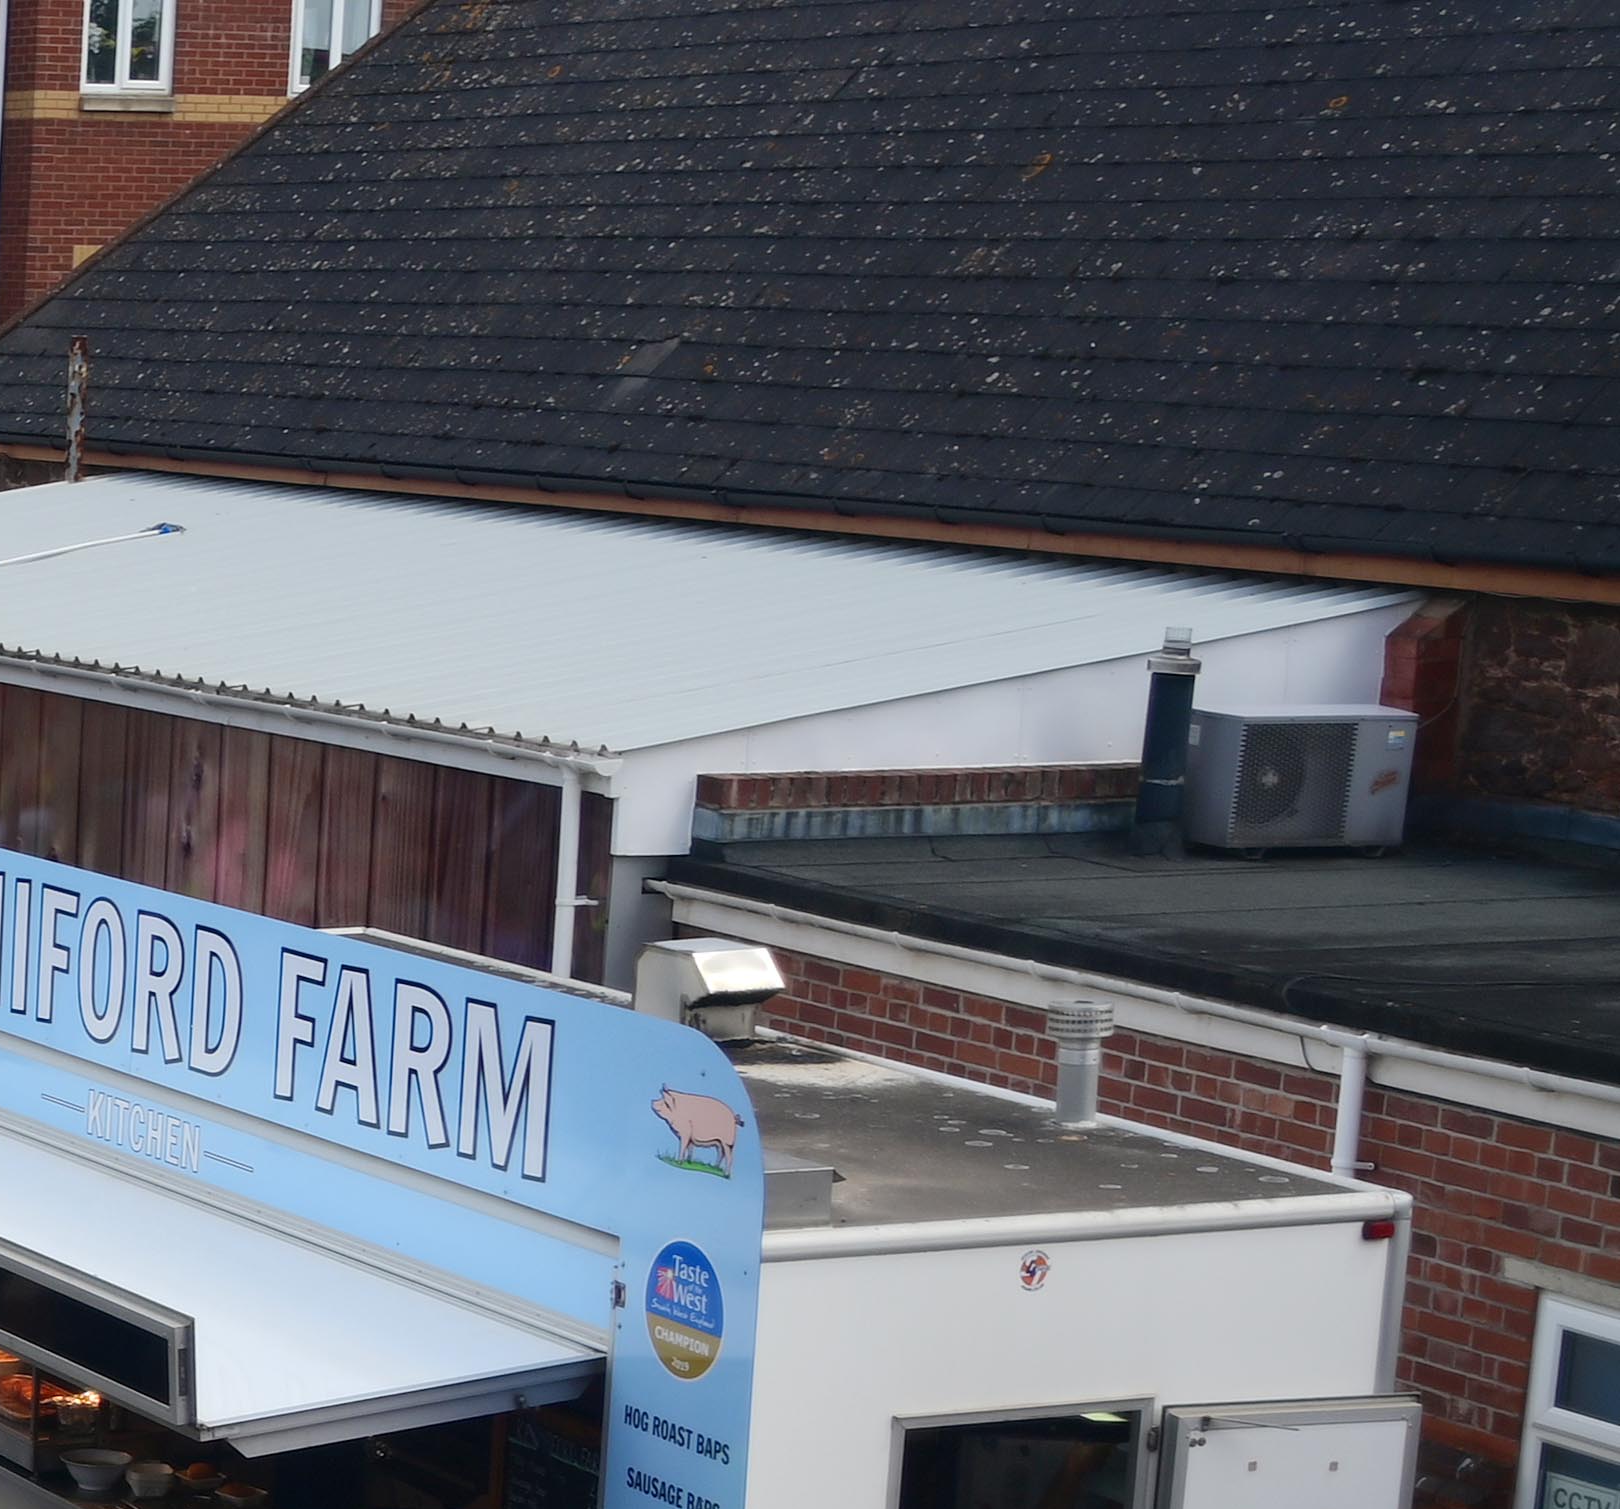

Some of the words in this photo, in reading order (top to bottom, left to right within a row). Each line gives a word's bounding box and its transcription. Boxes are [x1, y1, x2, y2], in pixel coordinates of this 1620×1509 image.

[273, 946, 556, 1183] FARM
[86, 1087, 201, 1174] KITCHEN
[672, 1254, 710, 1288] Taste
[672, 1281, 708, 1315] West
[654, 1326, 710, 1357] CHAMPION
[624, 1404, 649, 1433] HOG
[652, 1416, 693, 1451] ROAST
[696, 1433, 730, 1466] BAPS
[626, 1466, 683, 1509] SAUSAGE
